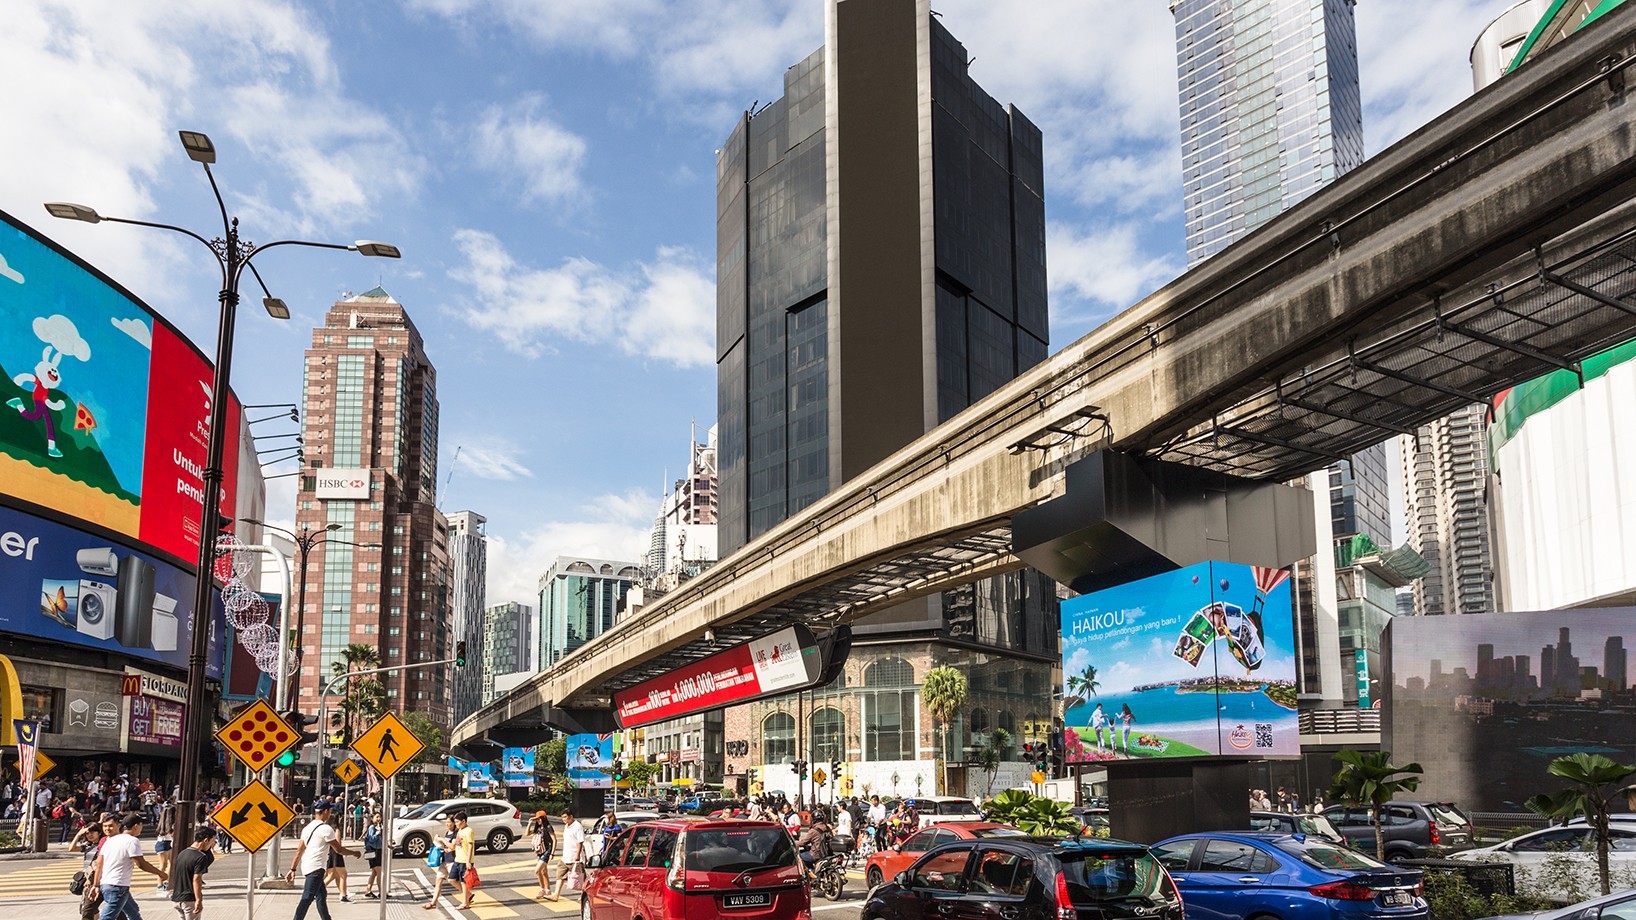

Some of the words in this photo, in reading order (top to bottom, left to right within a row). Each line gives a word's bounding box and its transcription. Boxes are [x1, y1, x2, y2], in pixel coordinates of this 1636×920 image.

[173, 448, 204, 481] Untuk
[177, 478, 205, 505] pemb
[320, 479, 348, 488] HSBC
[1072, 609, 1124, 635] HAIKOU
[1144, 620, 1160, 631] yang
[1161, 617, 1176, 626] baru
[142, 676, 188, 699] GIORDAN
[133, 699, 151, 717] BUY
[132, 718, 150, 735] GET
[157, 715, 180, 737] FREE
[745, 894, 764, 904] 5309
